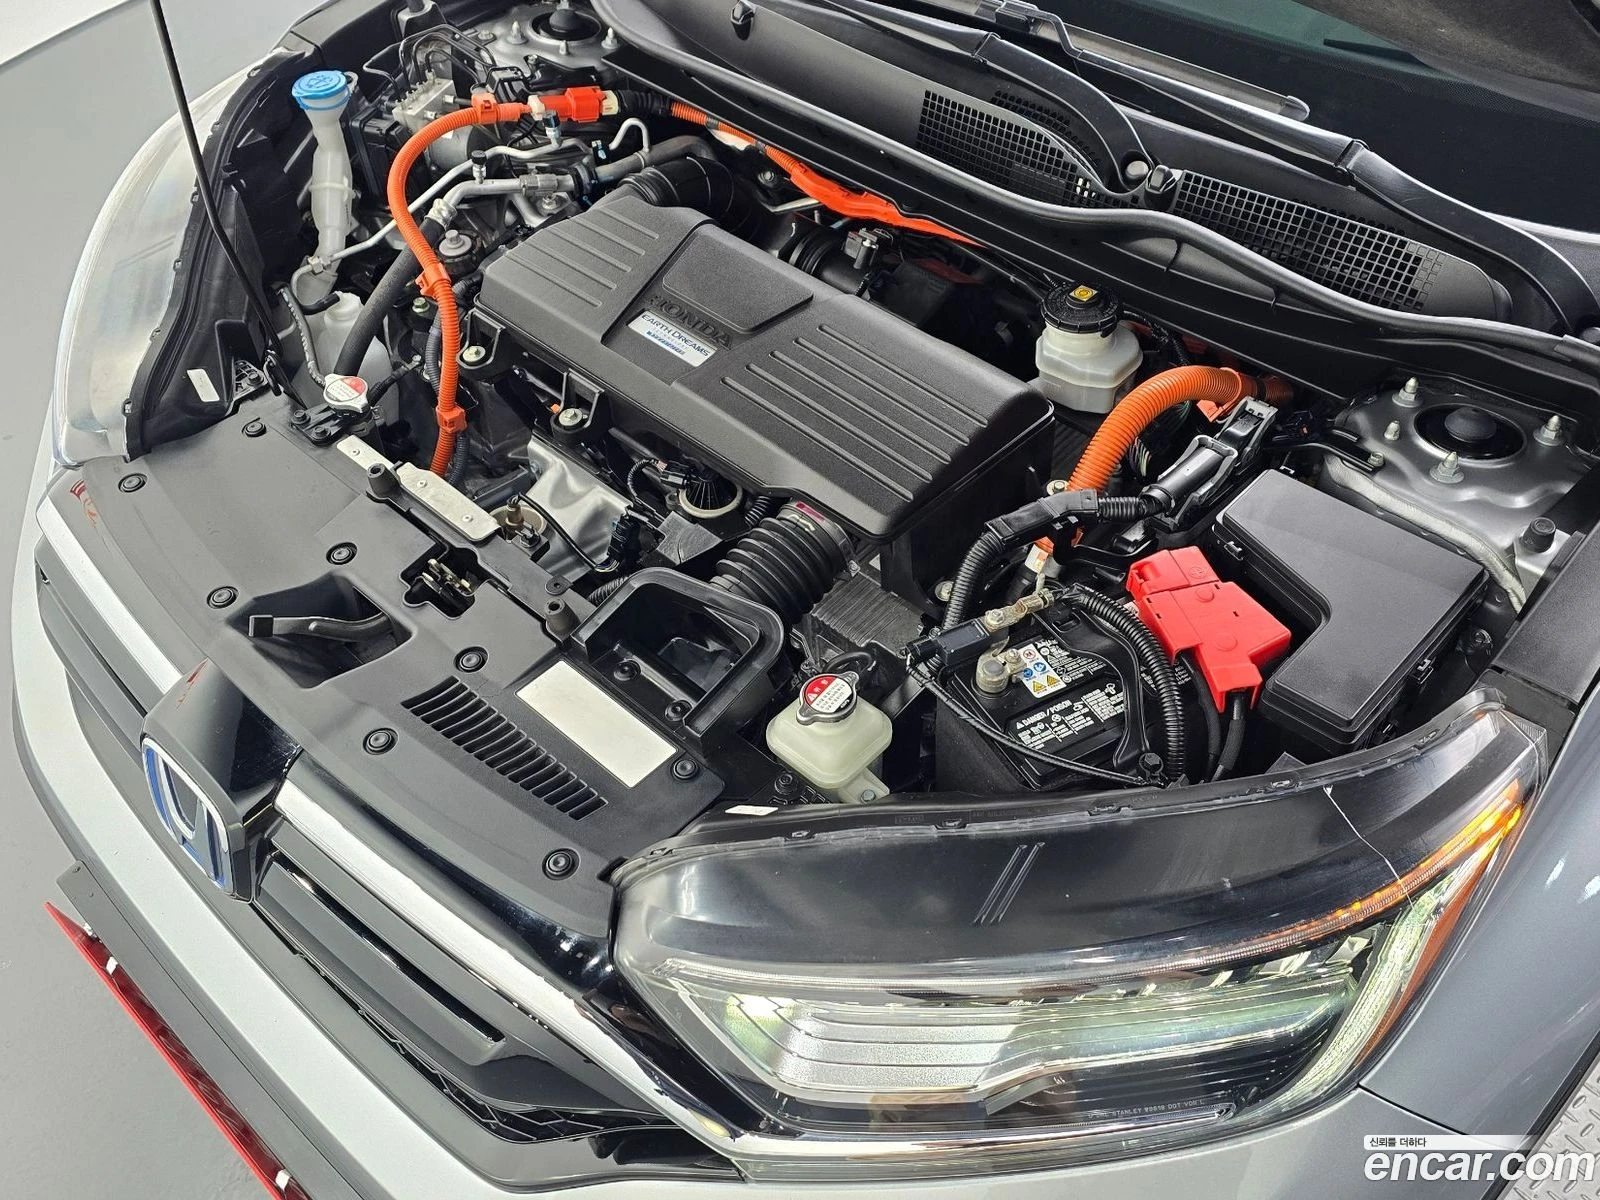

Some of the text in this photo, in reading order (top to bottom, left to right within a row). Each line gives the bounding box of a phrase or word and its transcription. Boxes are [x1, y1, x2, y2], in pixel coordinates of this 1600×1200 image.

[642, 314, 672, 335] EARTH
[671, 330, 711, 357] DREAMS
[646, 296, 732, 350] HONDA
[1022, 711, 1047, 726] DANGER
[1049, 699, 1072, 713] POISON
[1167, 1102, 1181, 1111] DOT
